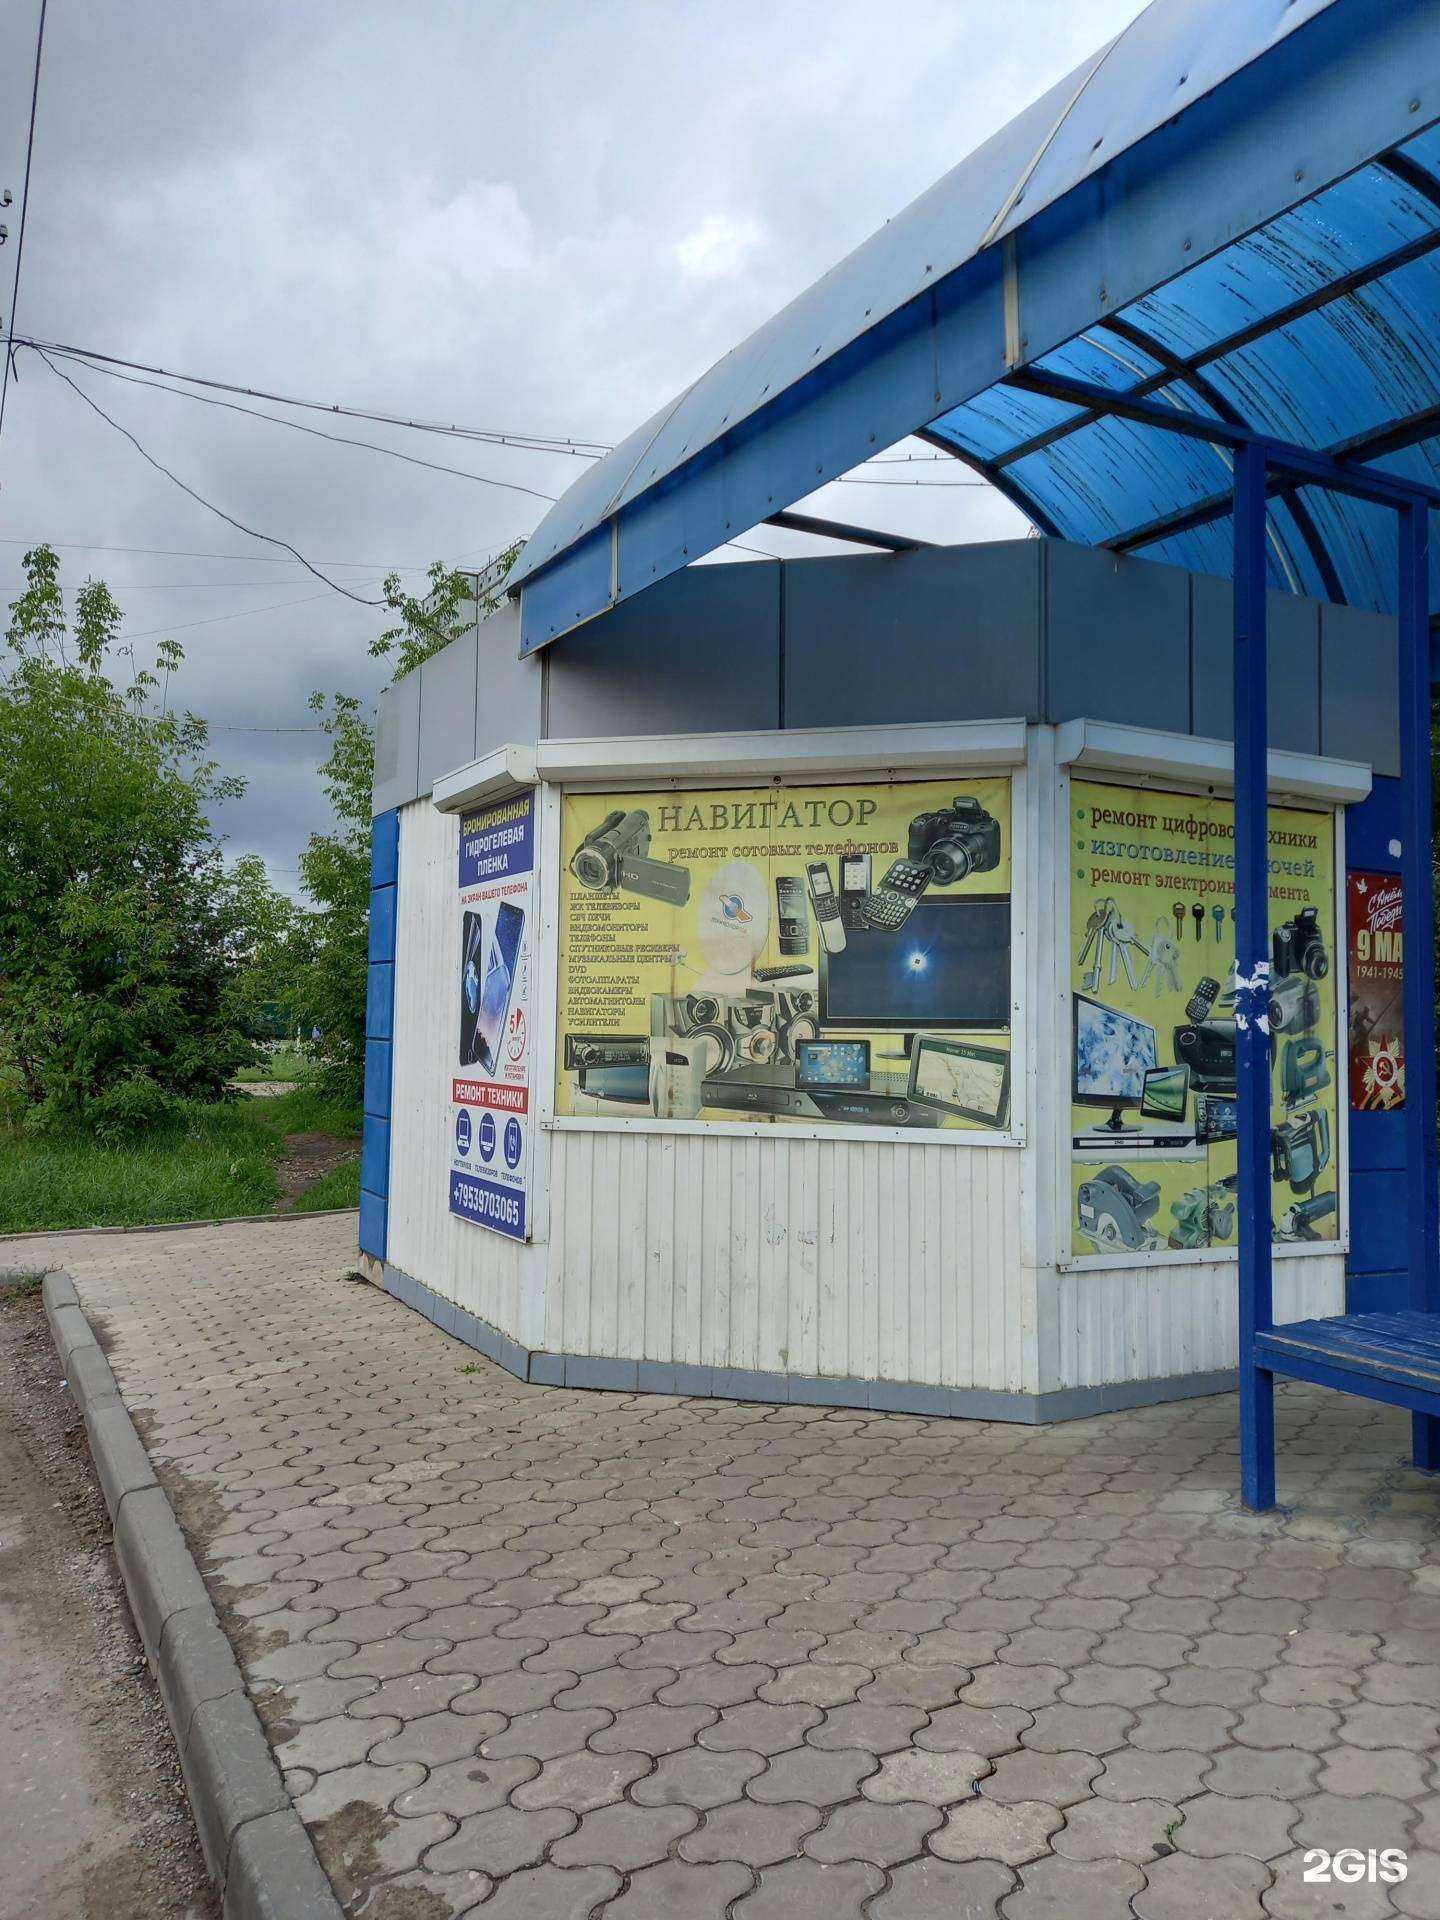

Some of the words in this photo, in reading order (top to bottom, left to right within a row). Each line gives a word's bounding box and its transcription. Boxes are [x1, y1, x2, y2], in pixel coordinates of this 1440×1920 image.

[463, 799, 530, 836] БРОНИРОВАННАЯ
[657, 799, 878, 832] НАВИГАТОР
[1090, 806, 1157, 829] ремонт
[1162, 813, 1236, 841] цифрово
[1267, 828, 1317, 849] хники
[465, 825, 525, 858] ГИДРОГЕЛЕВАЯ
[668, 846, 728, 863] ремонт
[732, 842, 801, 857] сотовых
[805, 838, 899, 856] телефонов
[1090, 838, 1236, 869] изготовление
[1267, 855, 1315, 878] ючей
[501, 882, 528, 896] ТЕЛЕФОНА
[1090, 866, 1151, 888] ремонт
[1155, 876, 1311, 902] электроинмента
[1357, 929, 1371, 962] 9
[1375, 931, 1403, 963] МА
[568, 965, 587, 974] DVD
[1356, 965, 1404, 981] 1941-1945
[510, 1014, 515, 1034] 5
[568, 1008, 626, 1017] НАВИГАТОРЫ
[568, 1018, 621, 1027] УСИЛИТЕЛИ
[455, 1083, 486, 1103] РЕМОНТ
[487, 1087, 524, 1109] ТЕХНИКИ
[453, 1182, 519, 1226] +79539703065
